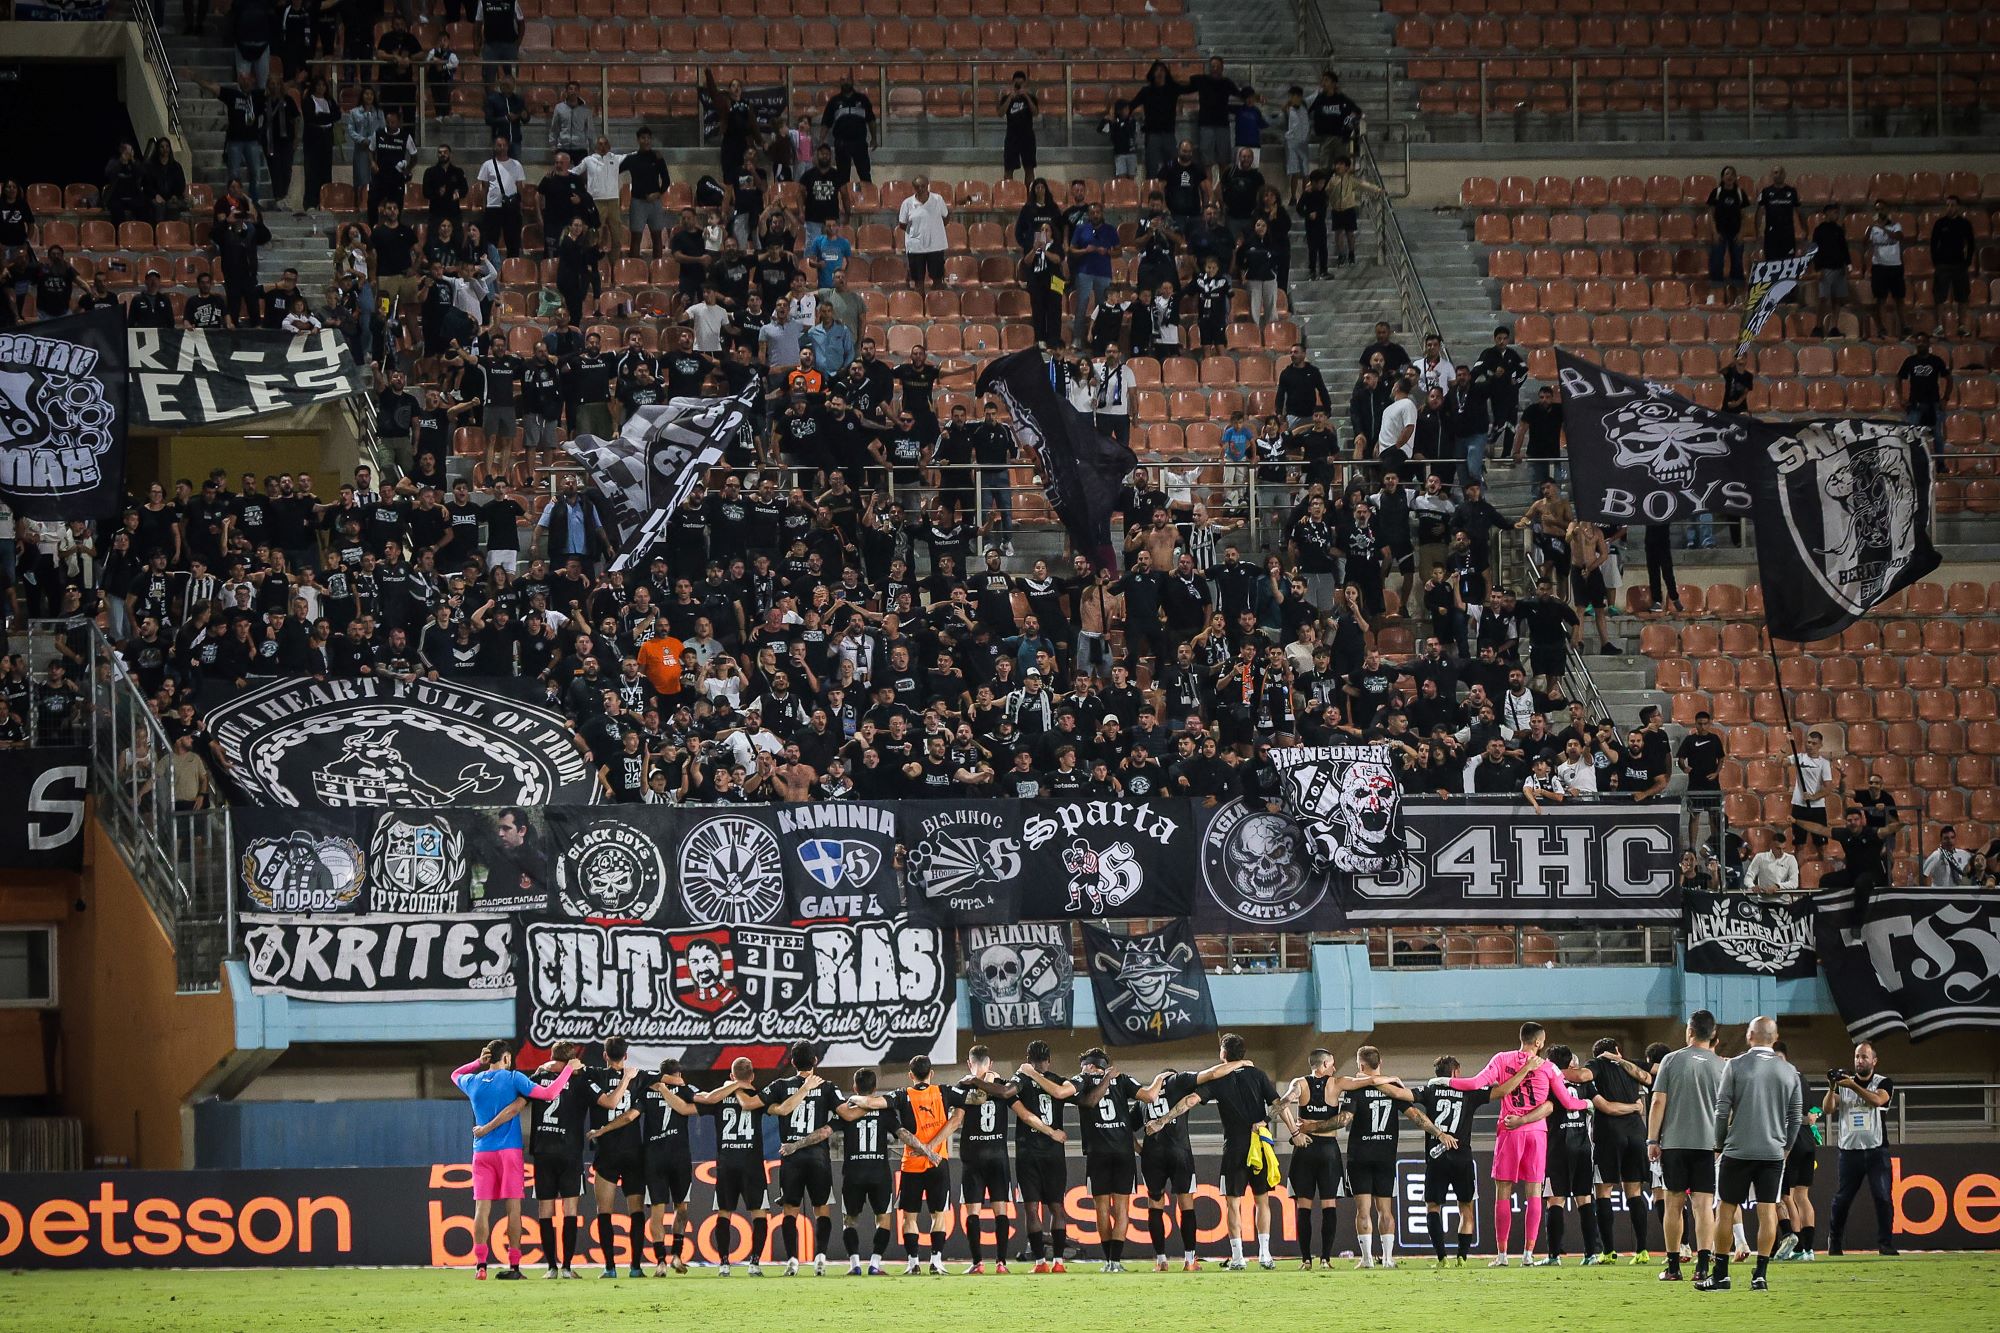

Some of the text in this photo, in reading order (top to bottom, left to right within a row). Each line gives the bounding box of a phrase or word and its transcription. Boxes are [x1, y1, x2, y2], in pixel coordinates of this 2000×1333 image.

[139, 364, 352, 422] ELES
[1600, 480, 1754, 523] BOYS
[246, 711, 266, 730] A
[265, 676, 380, 721] HEART
[393, 683, 485, 719] FULL
[492, 711, 536, 739] OF
[531, 727, 590, 788] PRIDE
[1268, 745, 1391, 771] BIANCONERI
[27, 766, 88, 850] S
[777, 803, 896, 838] KAMINIA
[1022, 799, 1181, 851] Sparta
[1209, 802, 1250, 849] AGIA
[567, 827, 651, 861] BLACK BOYS
[394, 857, 412, 885] 4
[685, 821, 783, 923] FROM THE HIGH MOUNTAINS
[272, 888, 339, 911] ΠΟΡΟΣ
[799, 893, 885, 919] GATE 4
[1236, 900, 1301, 919] GATE 4
[289, 922, 513, 989] KRITES
[746, 949, 795, 971] 2 0
[810, 928, 940, 1005] RAS
[1840, 903, 2000, 1004] TS
[745, 978, 794, 999] 0 3
[537, 1005, 937, 1039] From Rotterdam and Crete, side by side!
[985, 997, 1065, 1027] ΘΥΡΑ 4
[543, 1095, 561, 1124] 2
[658, 1099, 673, 1131] 7
[790, 1099, 816, 1134] 41
[980, 1099, 996, 1133] 8
[1038, 1093, 1053, 1126] 9
[1099, 1088, 1116, 1121] 5
[1313, 1105, 1328, 1113] hudl
[1369, 1099, 1393, 1133] 17
[1434, 1099, 1463, 1133] 21
[722, 1108, 755, 1141] 24
[856, 1119, 878, 1152] 11
